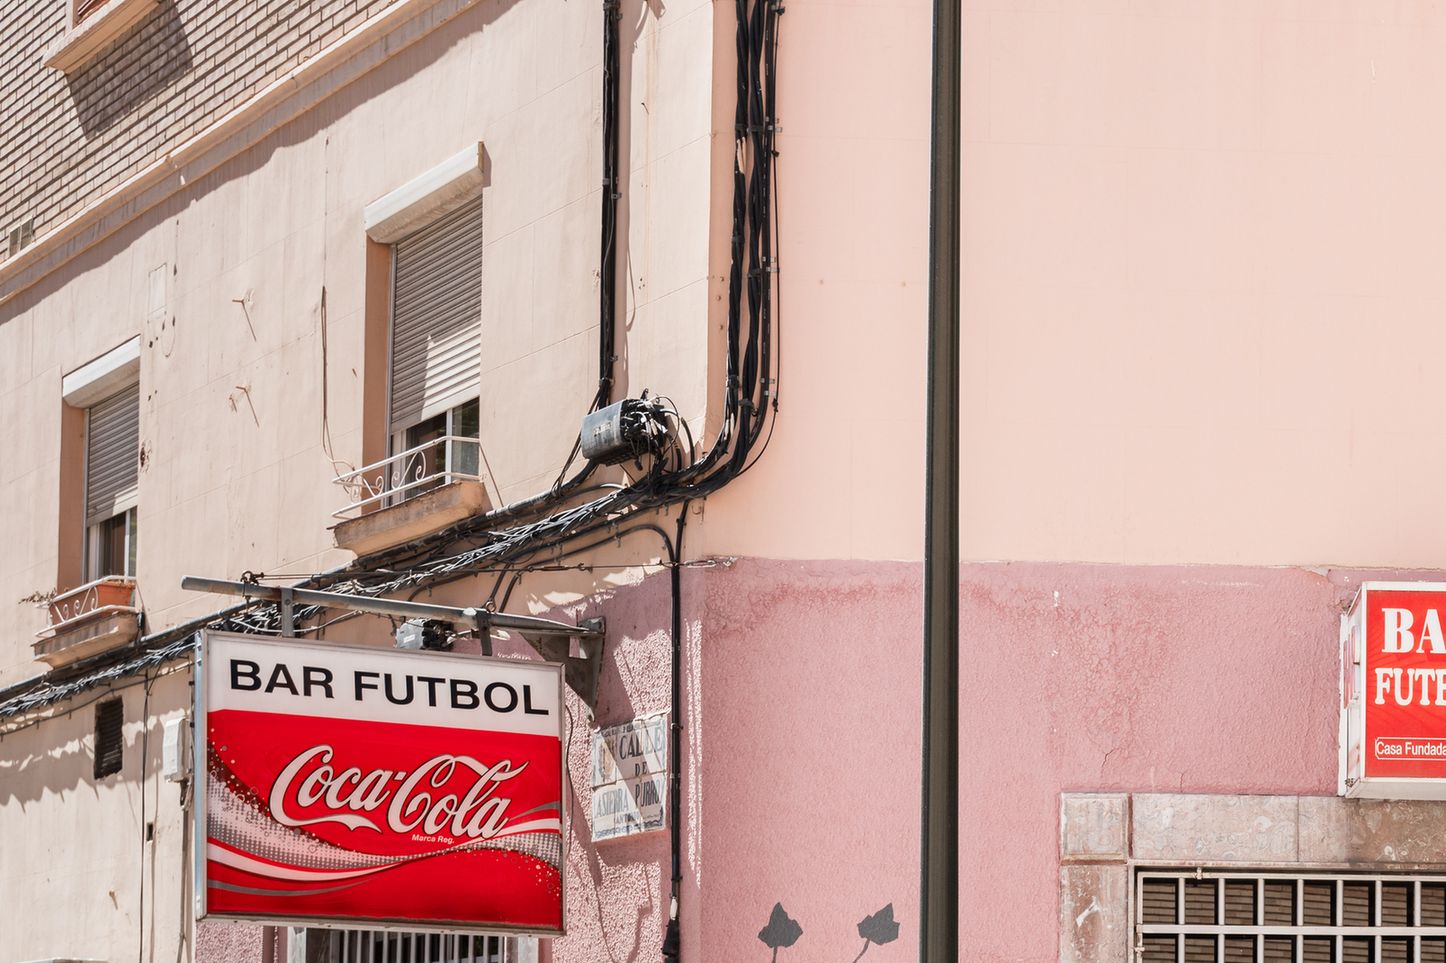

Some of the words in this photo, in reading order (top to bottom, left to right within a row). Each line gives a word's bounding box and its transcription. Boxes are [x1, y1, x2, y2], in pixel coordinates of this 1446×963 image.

[230, 658, 335, 699] BAR
[354, 671, 550, 716] FUTBOL
[618, 726, 663, 760] CALLE
[1376, 740, 1403, 755] Casa
[634, 761, 647, 777] DE
[269, 744, 530, 840] Coca-Cola
[411, 833, 436, 843] Marca
[437, 835, 456, 845] Reg.
